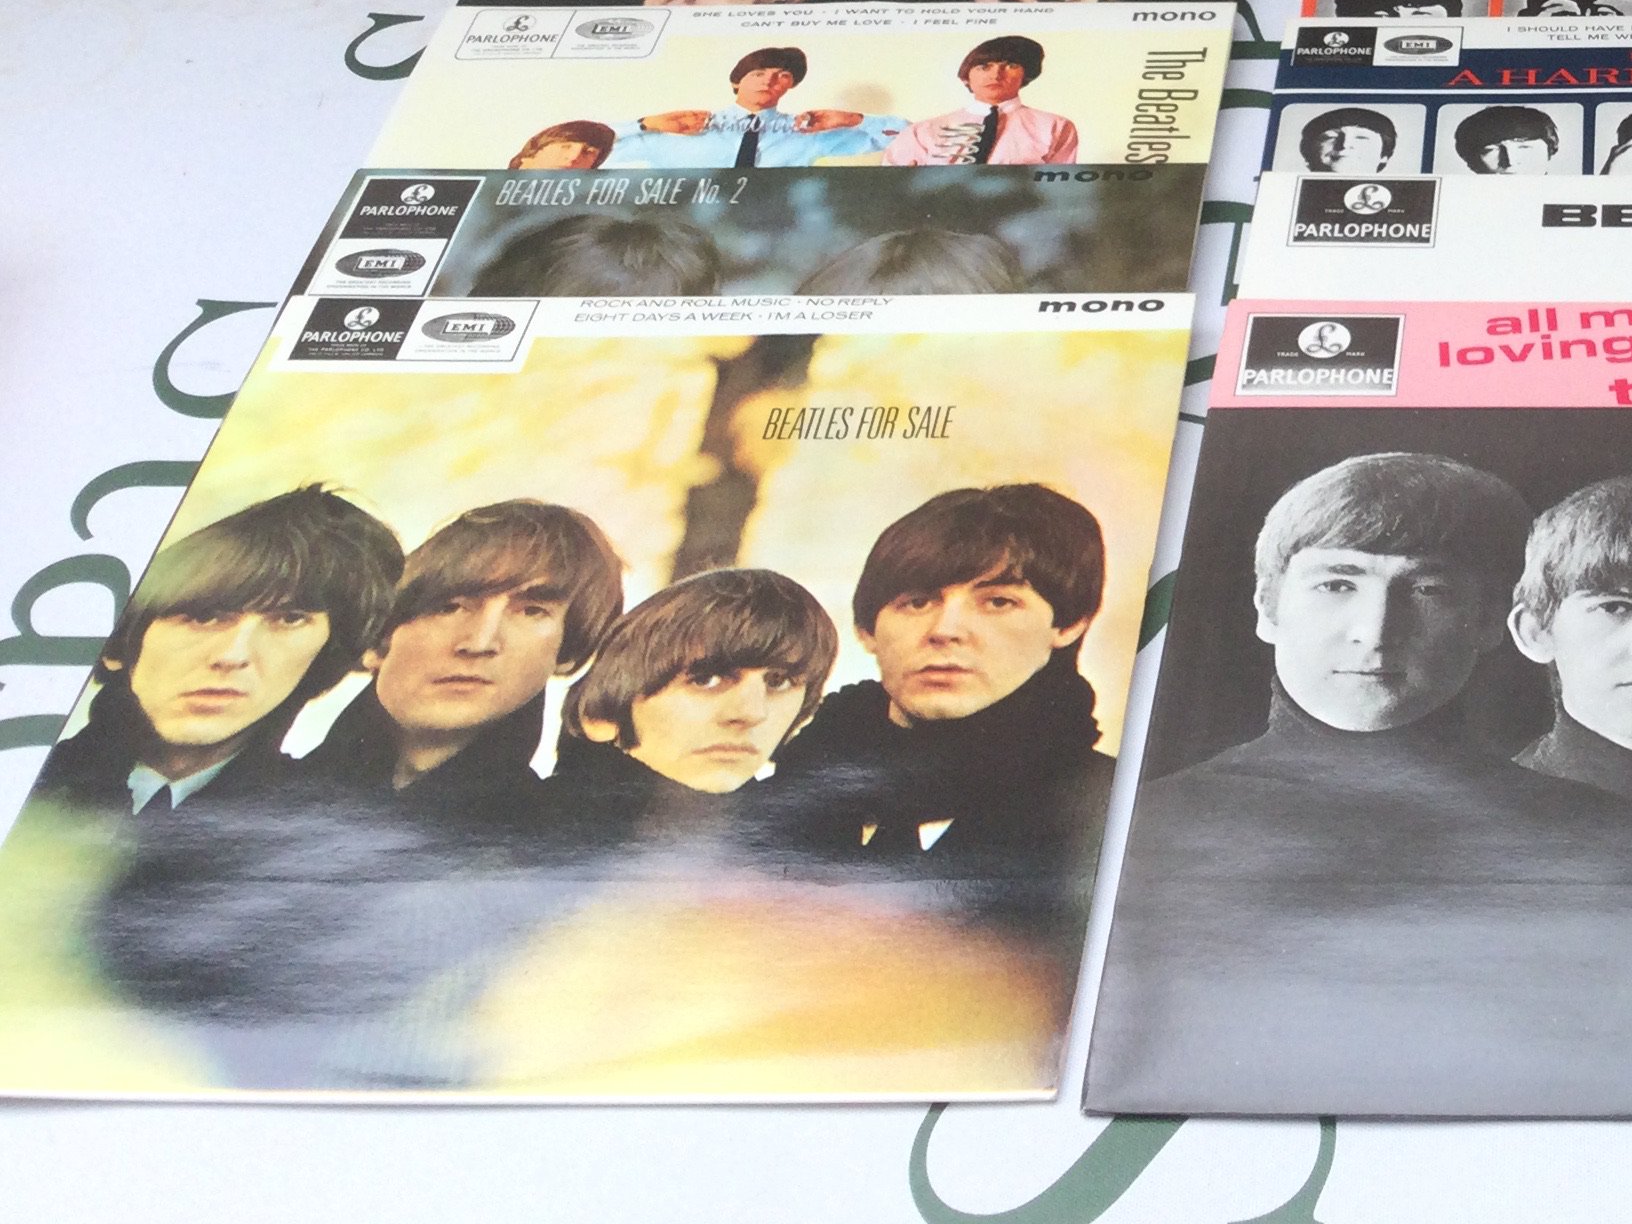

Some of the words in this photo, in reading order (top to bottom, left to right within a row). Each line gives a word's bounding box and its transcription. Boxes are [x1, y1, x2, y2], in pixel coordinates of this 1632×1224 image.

[728, 10, 779, 18] LOVES
[1132, 9, 1218, 23] mono
[740, 20, 785, 29] CAN'T
[790, 20, 824, 28] BUY
[854, 19, 892, 27] LOVE
[923, 18, 961, 26] FEEL
[466, 34, 559, 44] PARLOPHONE
[1297, 47, 1372, 56] PARLOPHONE
[1142, 47, 1208, 80] The
[1443, 68, 1485, 87] A
[1125, 89, 1198, 163] Beatles
[1032, 167, 1154, 183] mono
[496, 178, 581, 206] BEATLES
[587, 178, 630, 206] FOR
[634, 177, 683, 205] SALE
[692, 177, 721, 204] No.
[728, 177, 748, 205] 2
[359, 204, 459, 217] PARLOPHONE
[1294, 223, 1432, 238] PARLOPHONE
[580, 299, 633, 308] ROCK
[637, 299, 676, 308] AND
[681, 299, 728, 307] ROLL
[731, 298, 791, 307] MUSIC
[838, 298, 893, 306] REPLY
[1038, 298, 1166, 314] mono
[574, 313, 629, 322] EIGHT
[632, 313, 681, 321] DAYS
[702, 312, 753, 321] WEEK
[811, 311, 873, 320] LOSER
[1484, 309, 1559, 338] all
[301, 329, 404, 344] PARLOPHONE
[1243, 368, 1394, 385] PARLOPHONE
[762, 407, 853, 441] BEATLES
[855, 407, 899, 440] FOR
[903, 405, 957, 439] SALE
